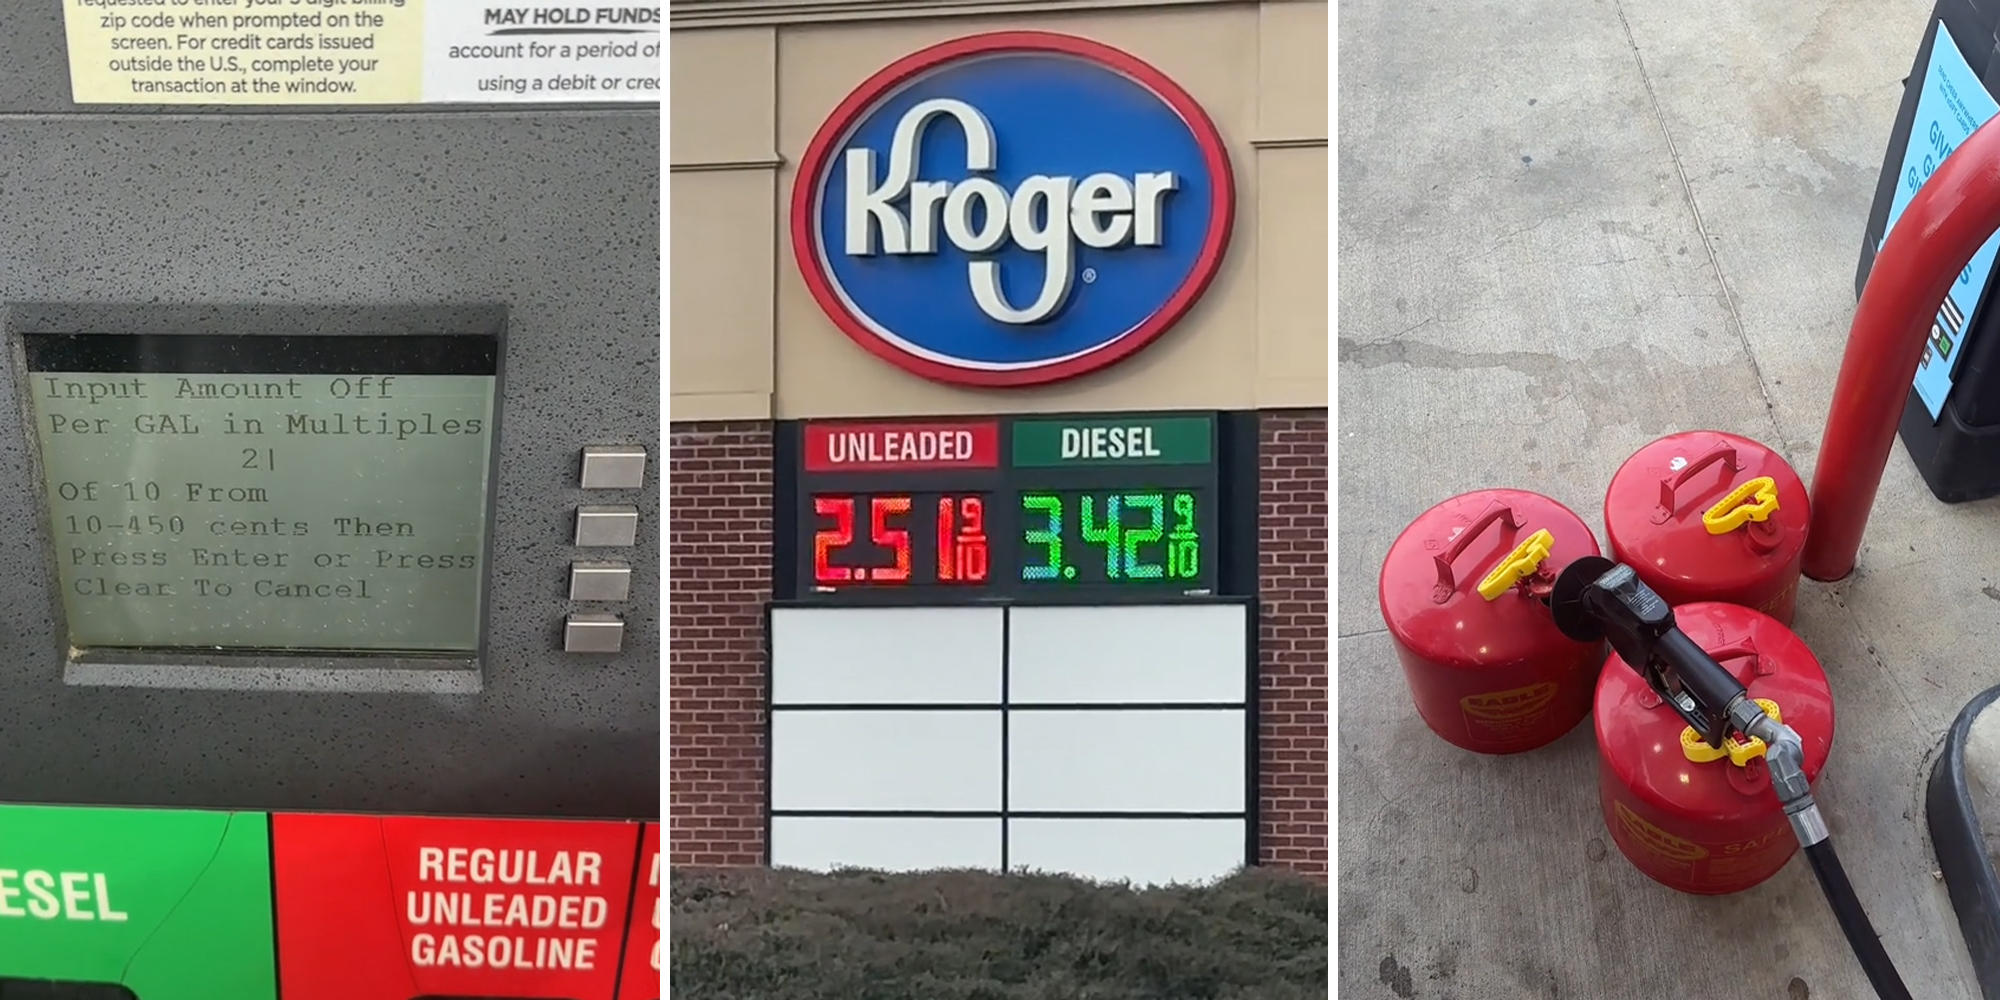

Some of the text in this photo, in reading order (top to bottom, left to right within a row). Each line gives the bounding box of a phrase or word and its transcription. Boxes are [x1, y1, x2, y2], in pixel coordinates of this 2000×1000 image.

[100, 11, 384, 31] zip code when prompted on the
[484, 7, 660, 24] MAY HOLD FUNDS
[111, 33, 374, 50] screen. For credit cards issued
[449, 43, 524, 58] account
[529, 41, 556, 58] for
[560, 46, 571, 58] a
[576, 41, 638, 61] period
[109, 56, 379, 75] outside the U.S., complete your
[131, 77, 357, 93] transaction at the window.
[478, 75, 527, 93] using
[532, 79, 543, 90] a
[547, 74, 597, 90] debit
[601, 78, 622, 90] or
[1930, 119, 1954, 160] GIV
[845, 97, 1179, 325] Kroger
[46, 376, 396, 404] Input Amount Off
[49, 412, 483, 440] Per GAL in Multiples
[828, 430, 974, 462] UNLEADED
[1061, 426, 1161, 459] DIESEL
[59, 482, 269, 502] Of 10 From
[66, 515, 415, 536] 10-450 cents Then
[815, 497, 953, 581] 2.51
[1022, 494, 1164, 580] 3.42
[71, 547, 476, 569] Press Enter or Press
[75, 578, 373, 599] Clear To Cancel
[419, 846, 602, 885] REGULAR
[0, 869, 127, 922] ESEL
[407, 891, 607, 929] UNLEADED
[411, 934, 598, 969] GASOLINE
